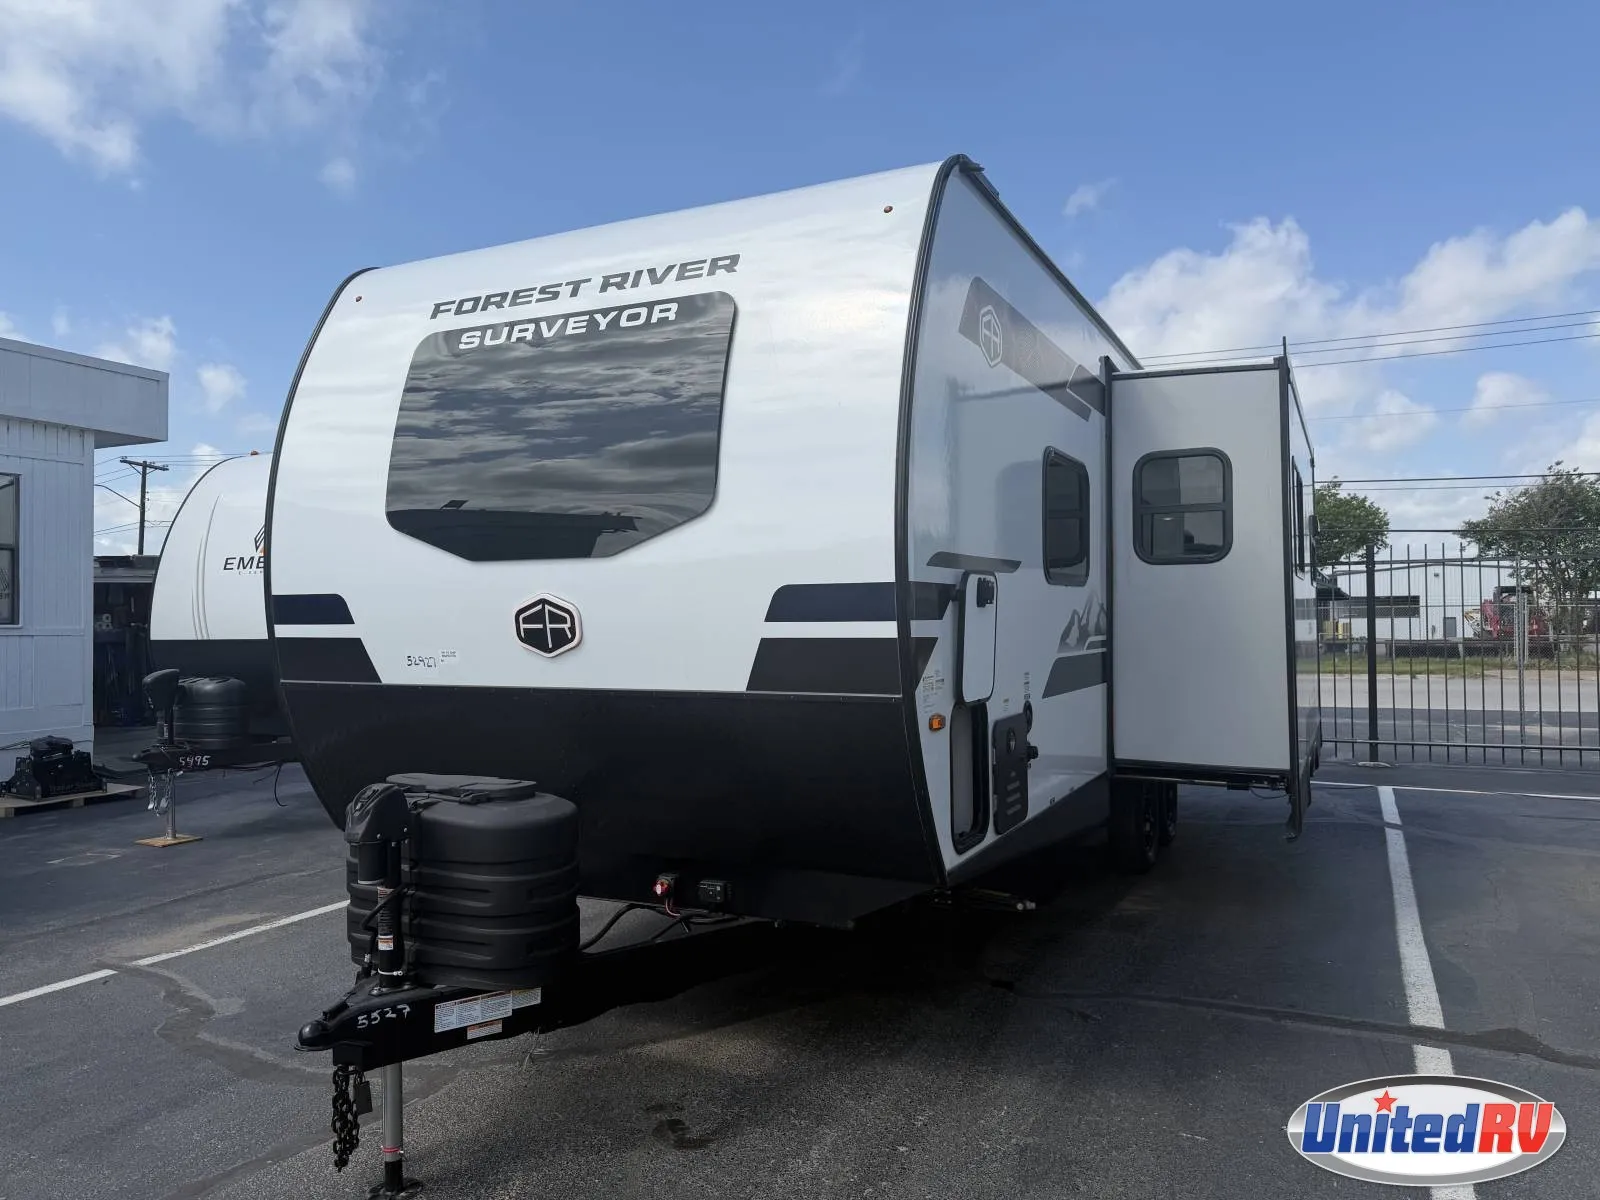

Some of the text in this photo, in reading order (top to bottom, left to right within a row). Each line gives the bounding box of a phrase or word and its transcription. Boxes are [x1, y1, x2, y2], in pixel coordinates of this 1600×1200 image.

[430, 253, 741, 320] FOREST RIVER
[458, 302, 679, 350] SURVEYOR
[356, 1003, 411, 1029] 5527
